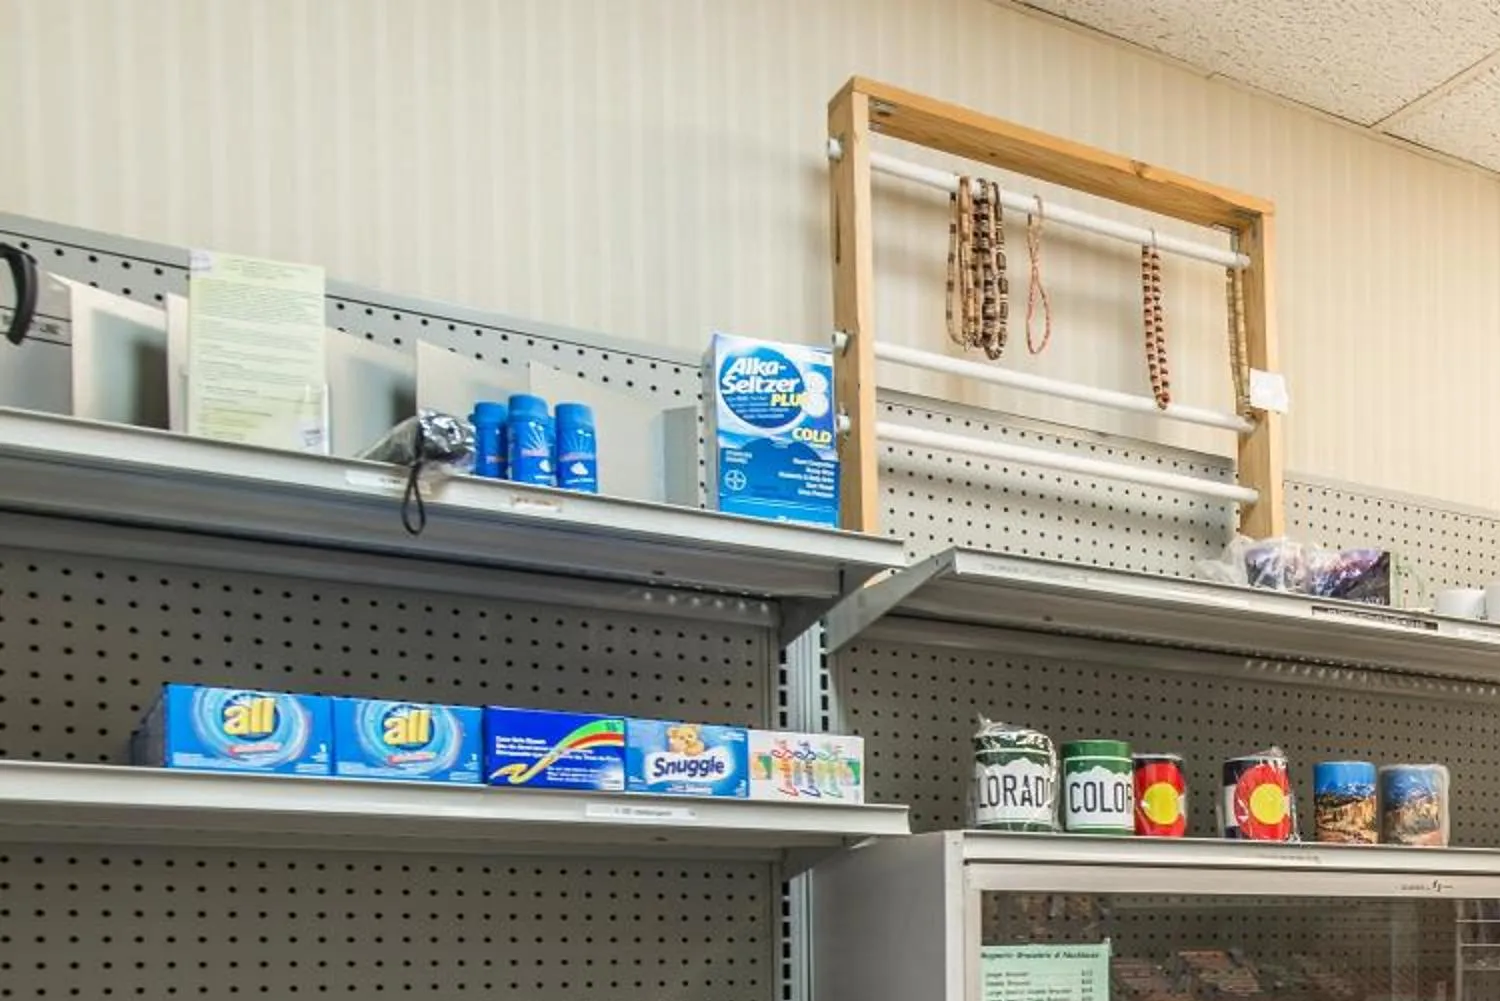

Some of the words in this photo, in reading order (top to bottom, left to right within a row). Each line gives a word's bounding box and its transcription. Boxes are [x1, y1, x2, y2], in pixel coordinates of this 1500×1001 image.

[724, 357, 787, 377] Alka-
[721, 373, 801, 394] Seltzer
[791, 426, 832, 443] COLD
[223, 697, 276, 737] all
[383, 710, 432, 745] all
[653, 756, 724, 777] Snuggle
[979, 775, 1051, 809] LORAD
